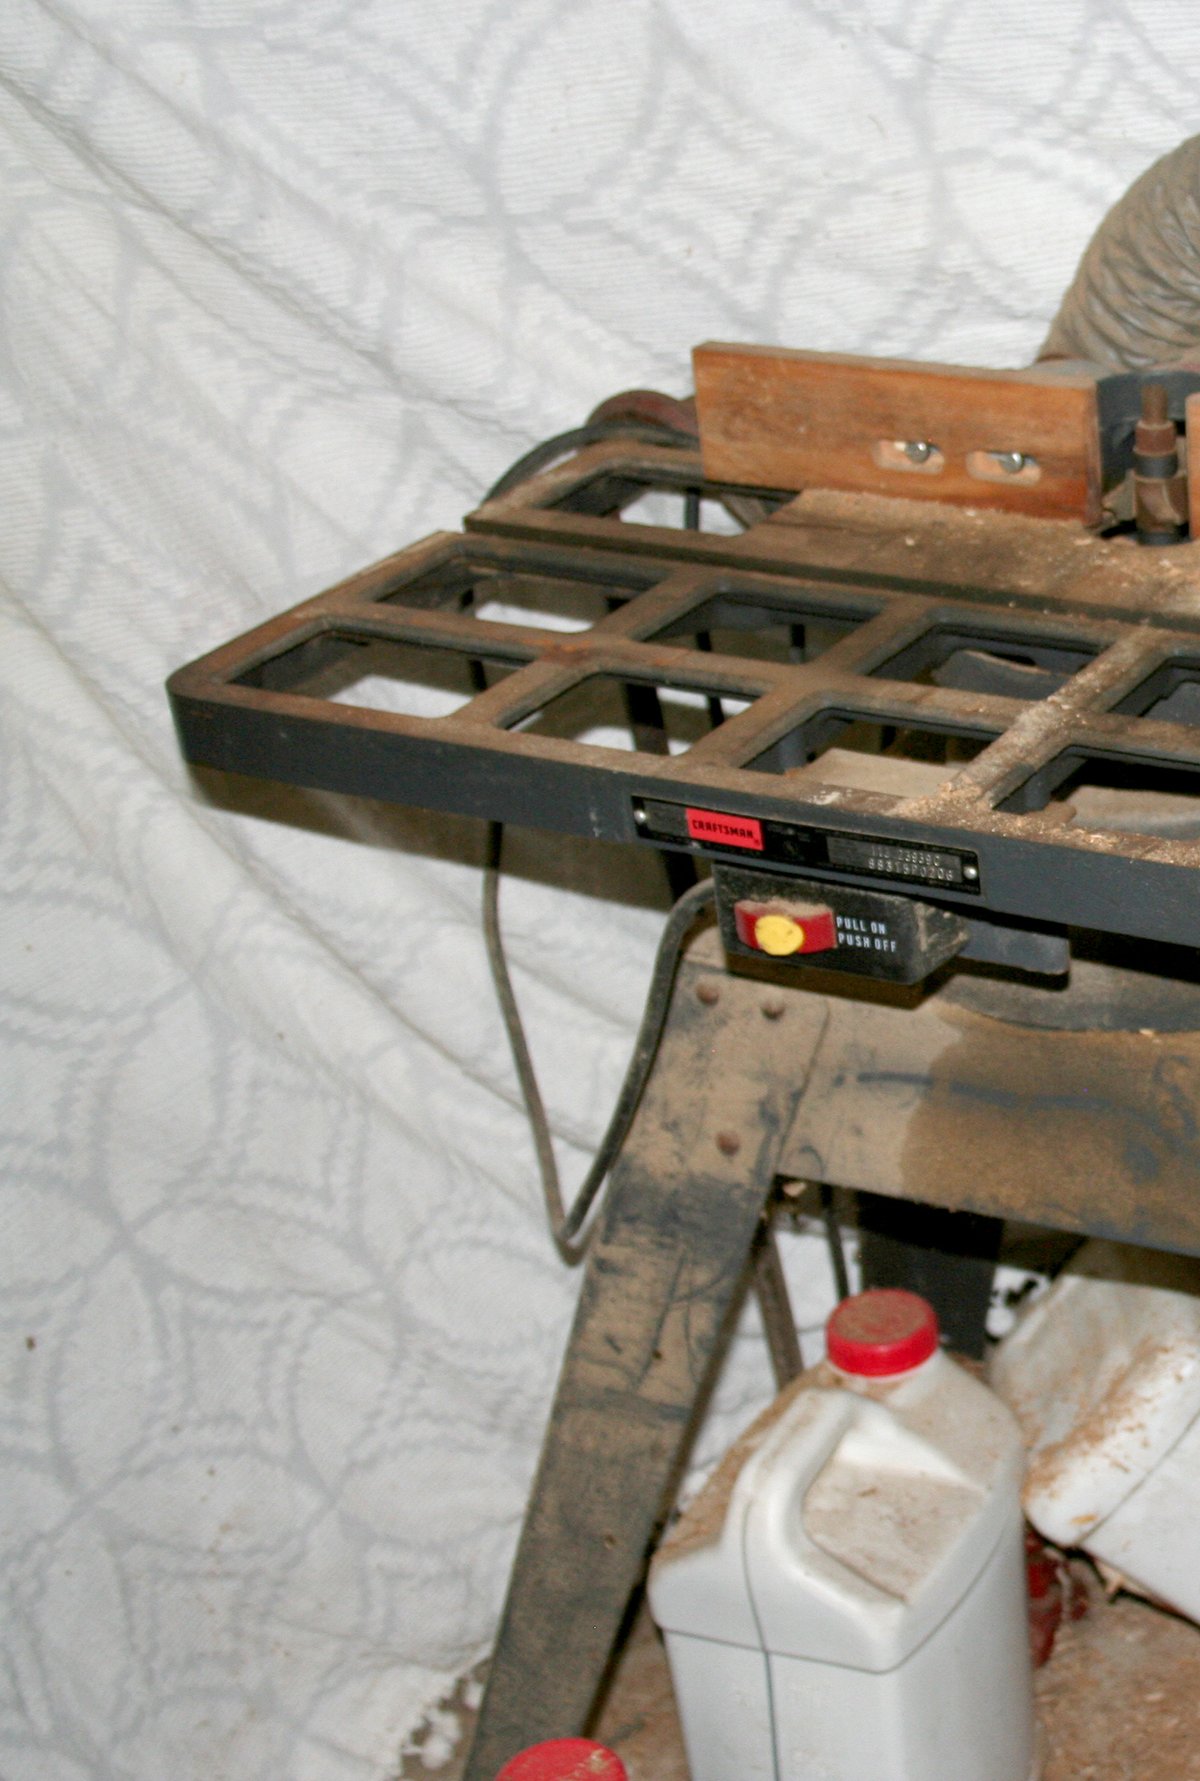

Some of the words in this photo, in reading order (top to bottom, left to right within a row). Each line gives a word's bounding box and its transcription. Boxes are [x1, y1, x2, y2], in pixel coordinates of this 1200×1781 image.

[692, 819, 753, 838] CRAFTSMAN
[836, 916, 867, 932] PULL
[870, 921, 886, 934] ON
[838, 932, 870, 948] PUSH
[874, 938, 896, 953] OFF
